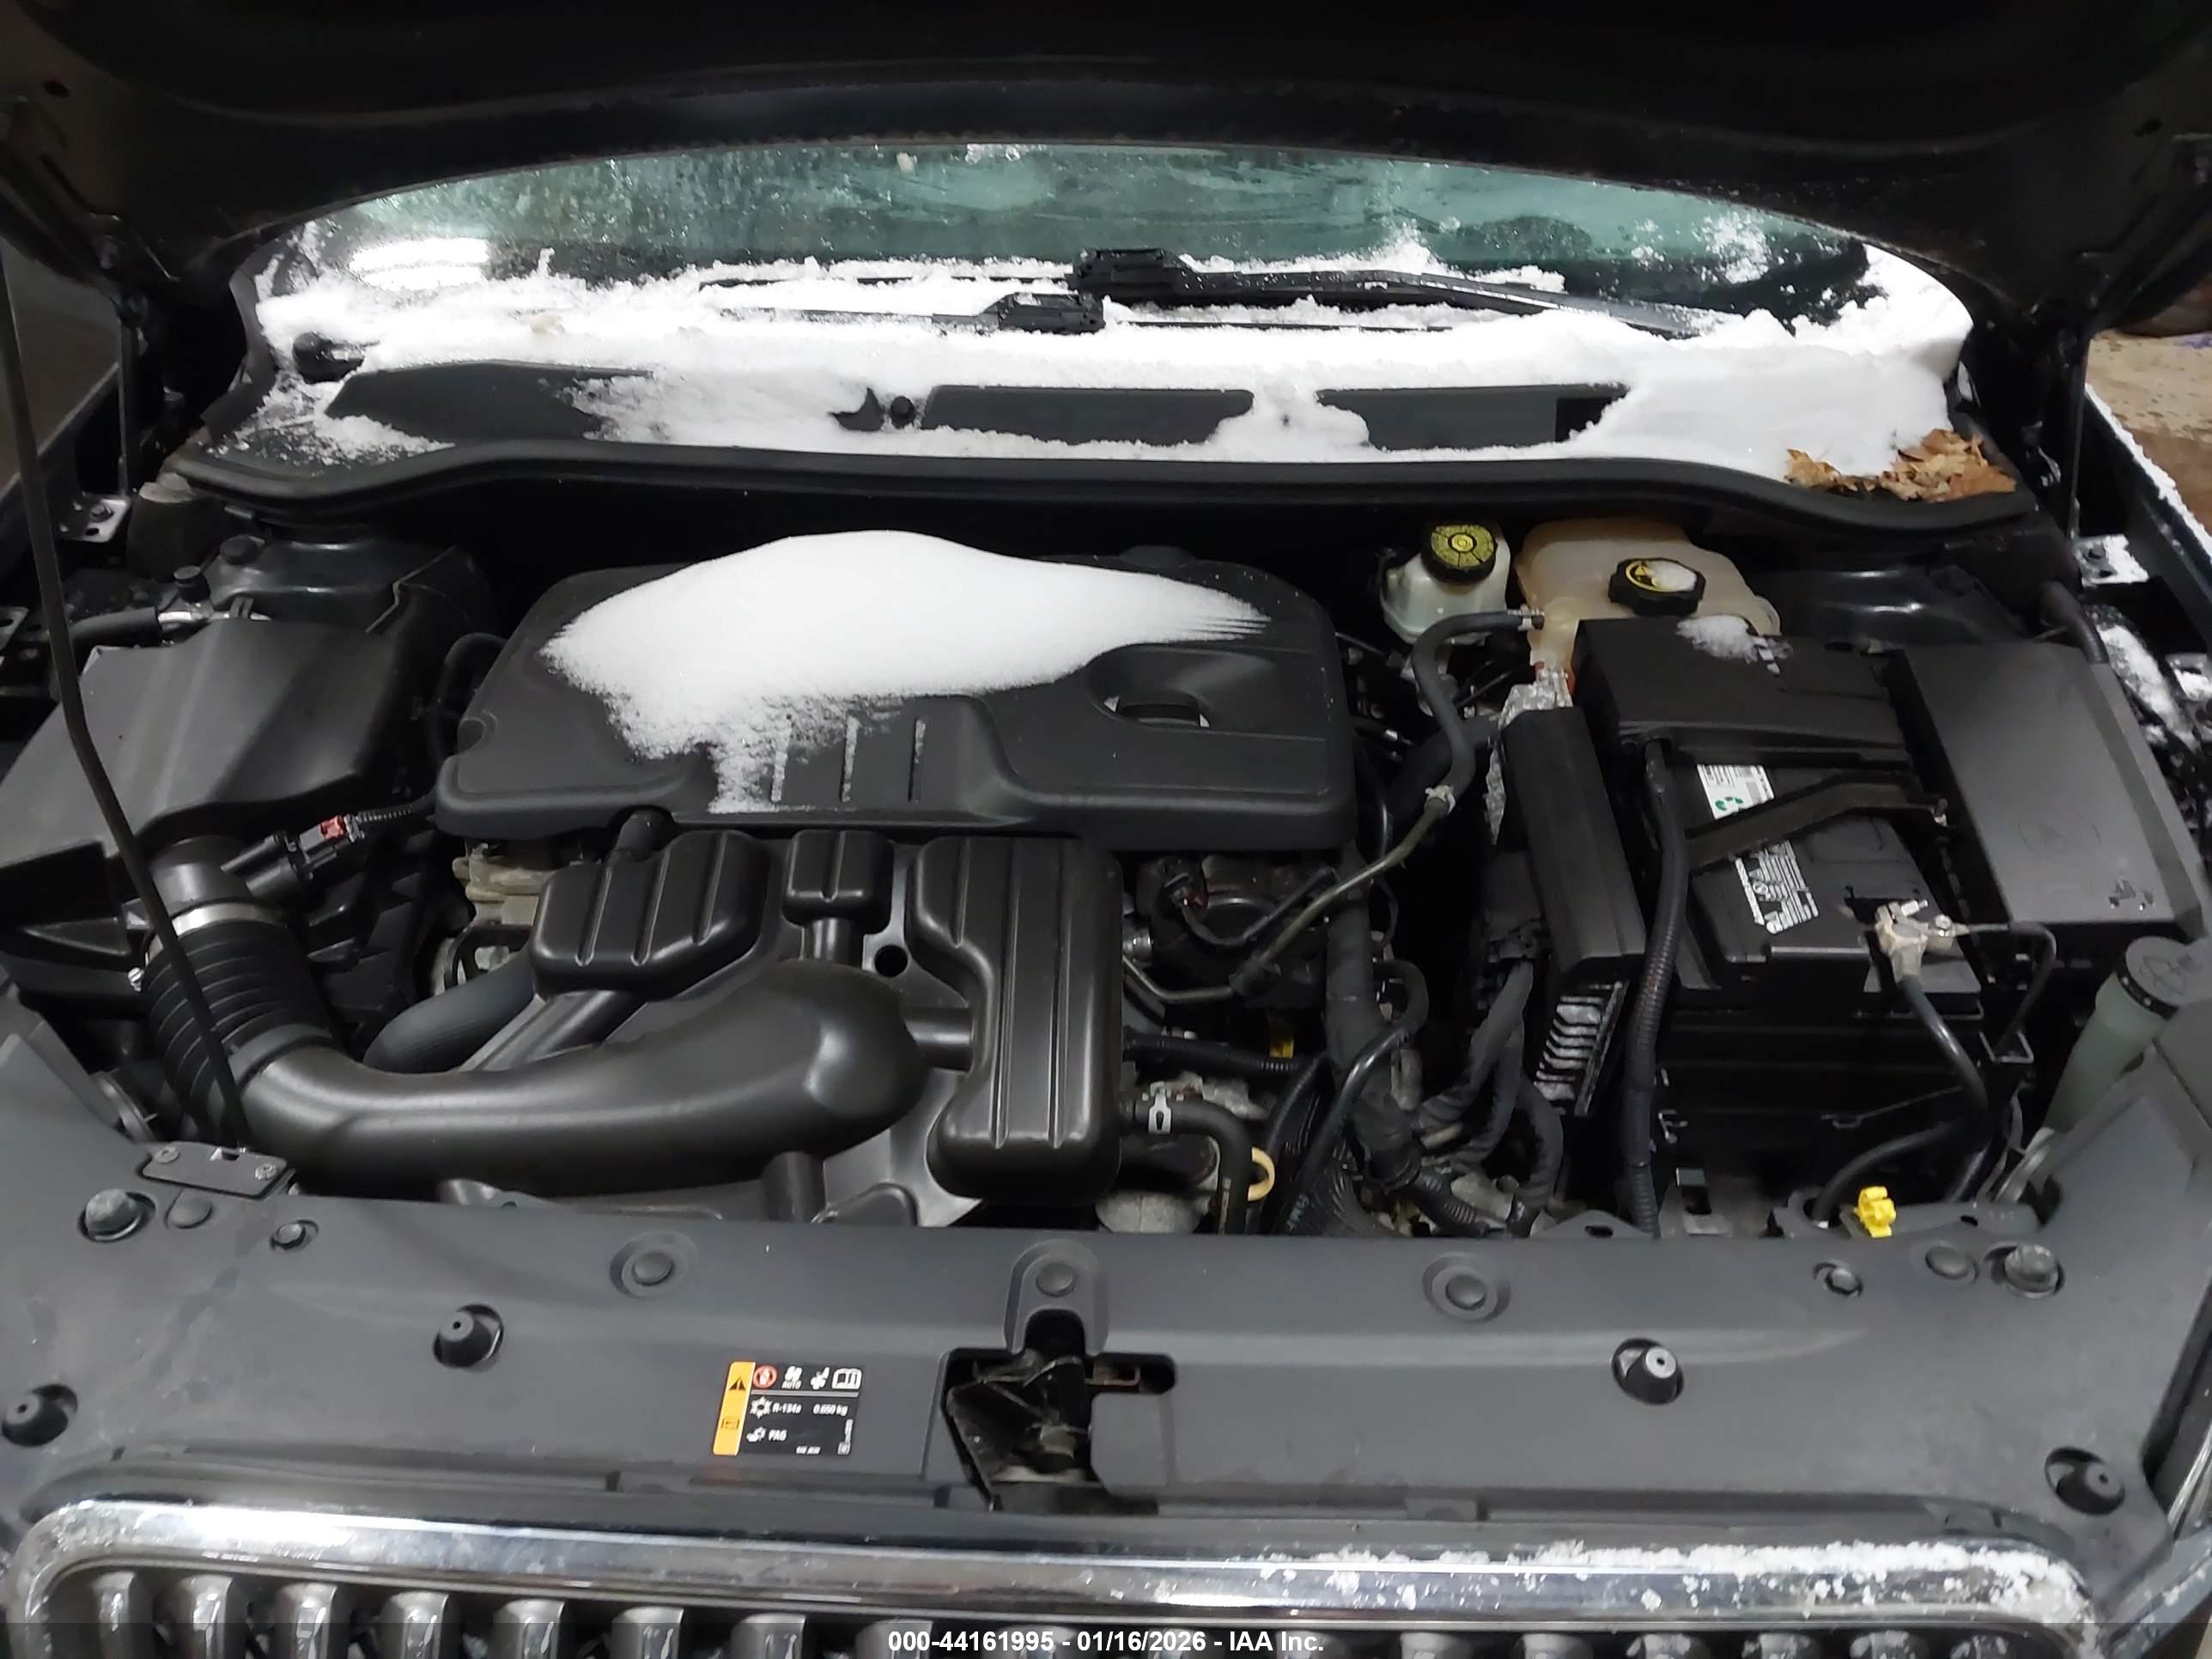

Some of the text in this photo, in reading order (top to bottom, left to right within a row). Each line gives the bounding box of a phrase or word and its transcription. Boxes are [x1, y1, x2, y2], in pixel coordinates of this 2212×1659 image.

[781, 1380, 802, 1389] AUTO
[772, 1402, 802, 1413] R-134a
[836, 1405, 848, 1417] kg
[769, 1430, 787, 1441] PAG
